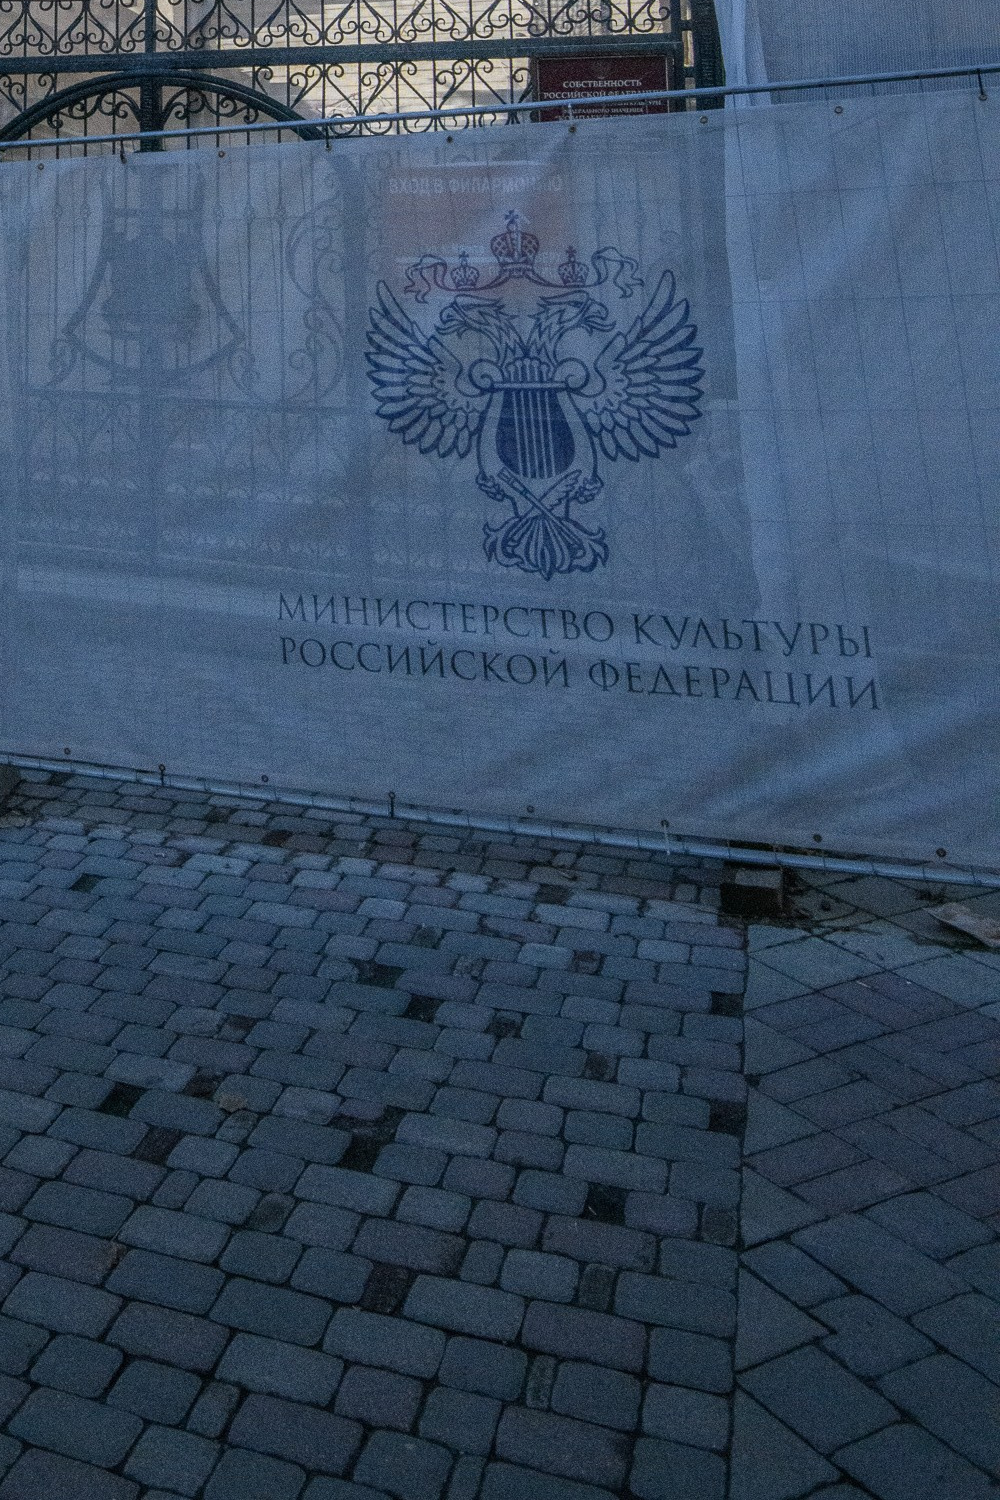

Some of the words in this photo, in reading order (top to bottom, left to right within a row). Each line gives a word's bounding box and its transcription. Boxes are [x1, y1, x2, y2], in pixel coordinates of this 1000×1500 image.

[563, 79, 642, 88] СОБСТВЕННОСТЬ
[543, 90, 606, 99] РОССИЙСКОЙ
[389, 177, 431, 197] ВХОД
[434, 178, 445, 193] В
[277, 592, 615, 642] МИНИСТЕРСТВО
[630, 612, 874, 659] КУЛЬТУРЫ
[279, 636, 570, 688] РОССИЙСКОЙ
[587, 657, 881, 711] ФЕДЕРАЦИИ
